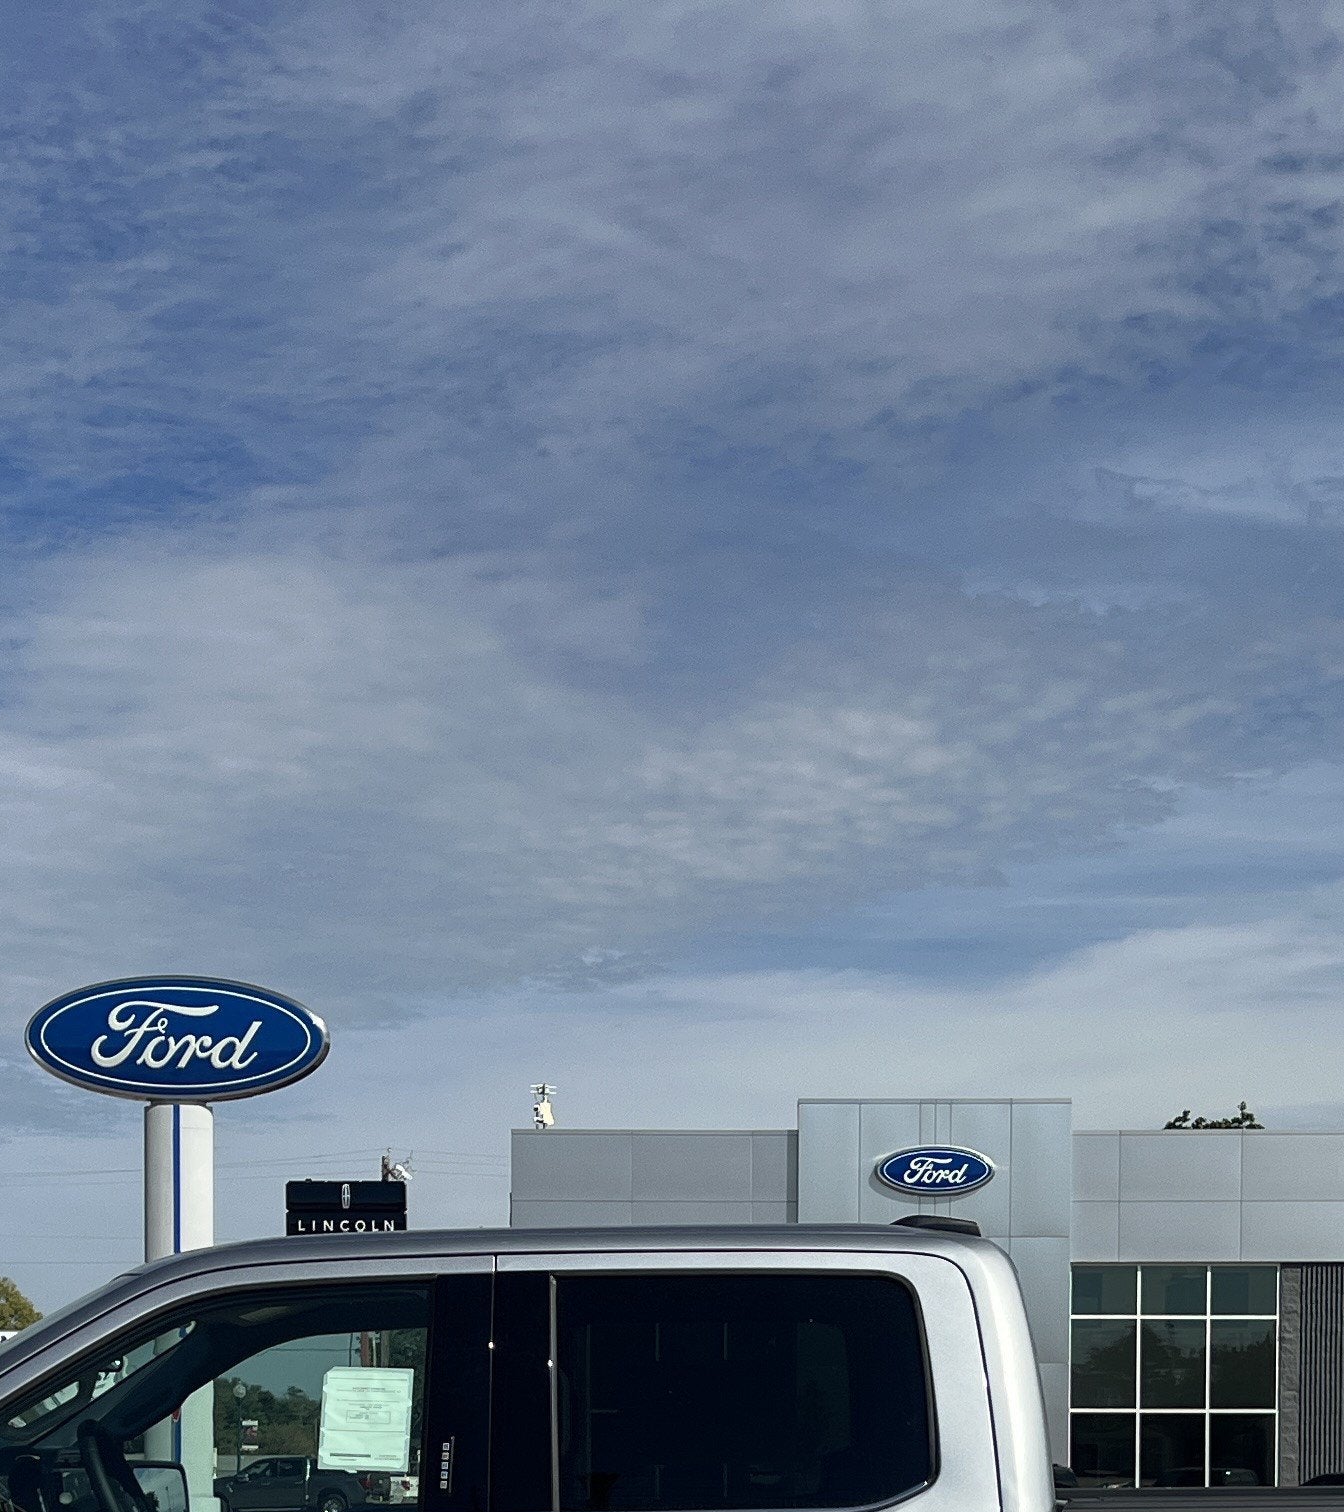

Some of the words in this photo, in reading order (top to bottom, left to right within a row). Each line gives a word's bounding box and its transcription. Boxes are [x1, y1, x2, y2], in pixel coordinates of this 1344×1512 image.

[90, 1000, 263, 1070] Ford
[903, 1156, 969, 1184] Ford
[297, 1220, 395, 1232] LINCOLN
